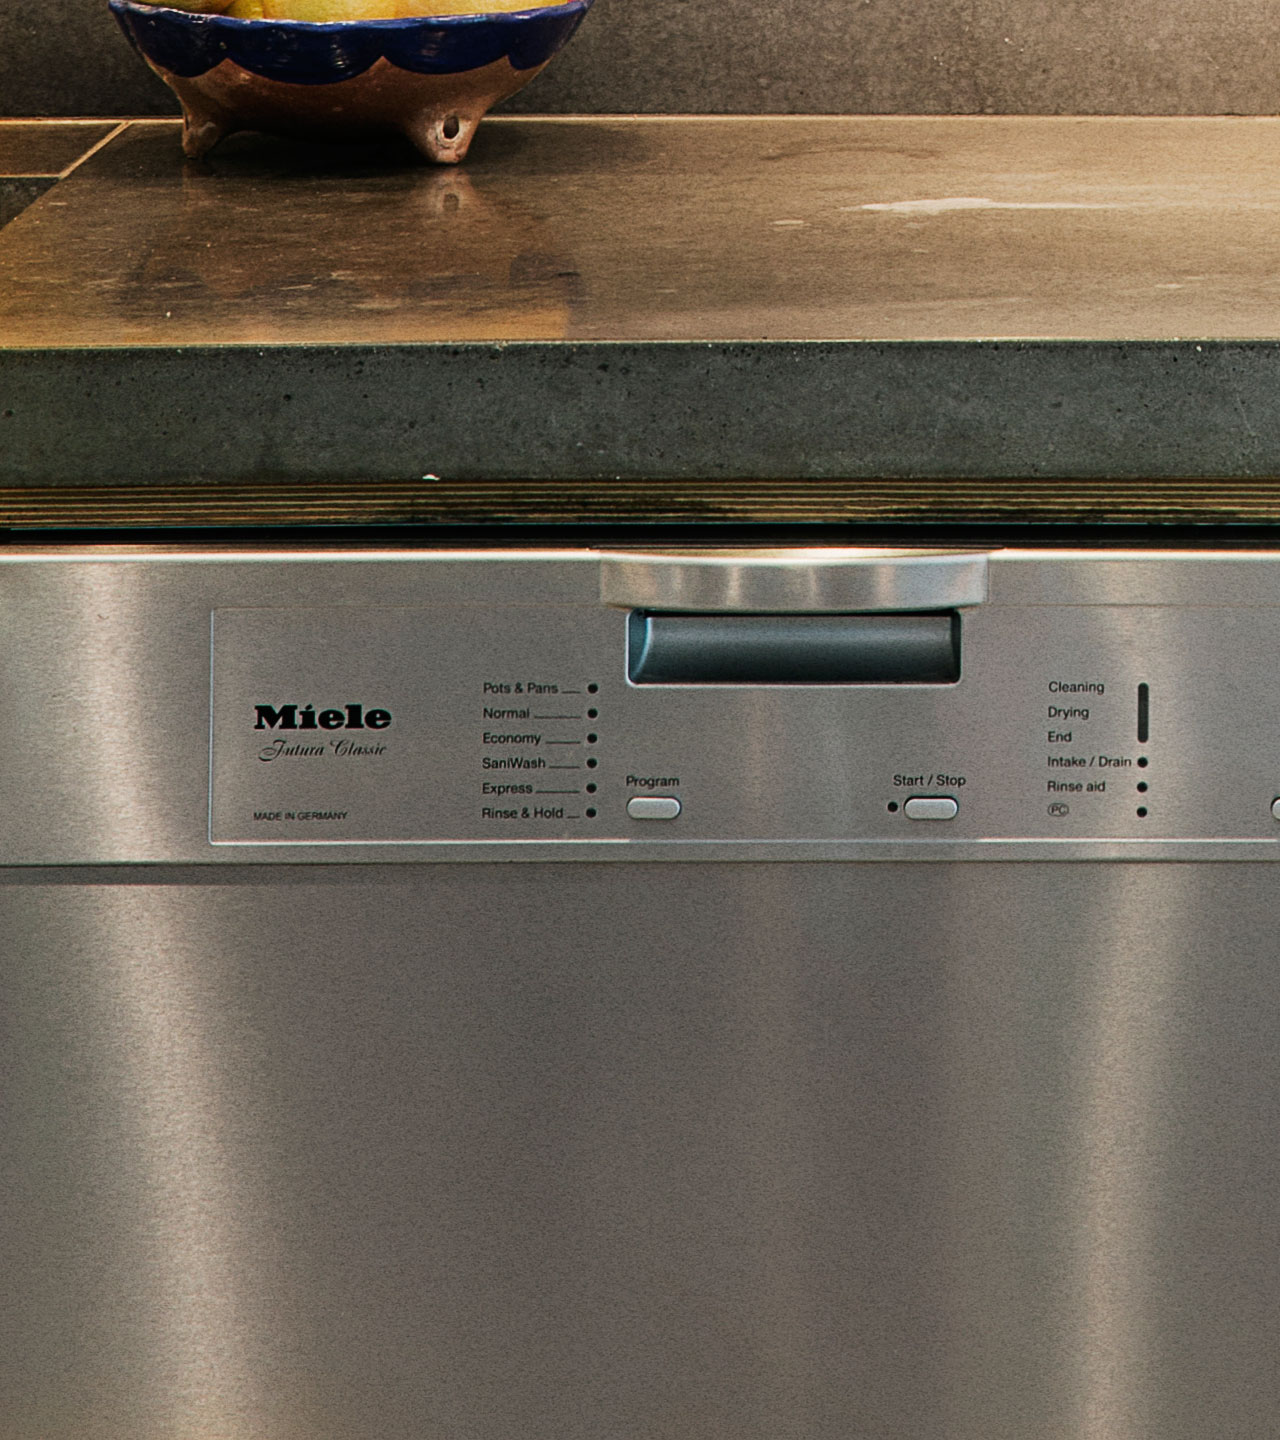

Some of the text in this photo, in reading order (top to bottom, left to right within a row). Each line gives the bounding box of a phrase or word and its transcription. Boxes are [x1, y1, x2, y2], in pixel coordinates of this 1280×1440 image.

[483, 683, 558, 694] Pots & Pans
[1048, 681, 1104, 695] Cleaning
[254, 704, 392, 730] Miele
[483, 708, 530, 719] Normal
[1048, 706, 1089, 720] Drying
[483, 733, 541, 746] Economy
[1048, 731, 1072, 742] End
[258, 738, 387, 762] Futura Classic
[482, 757, 546, 769] SaniWash
[1047, 756, 1132, 767] Intake / Drain
[626, 775, 680, 789] Program
[893, 774, 967, 788] Start / Stop
[1047, 781, 1106, 792] Rinse aid
[482, 783, 533, 795] Express
[253, 811, 348, 821] MADE IN GERMANY
[482, 808, 564, 819] Rinse & Hold
